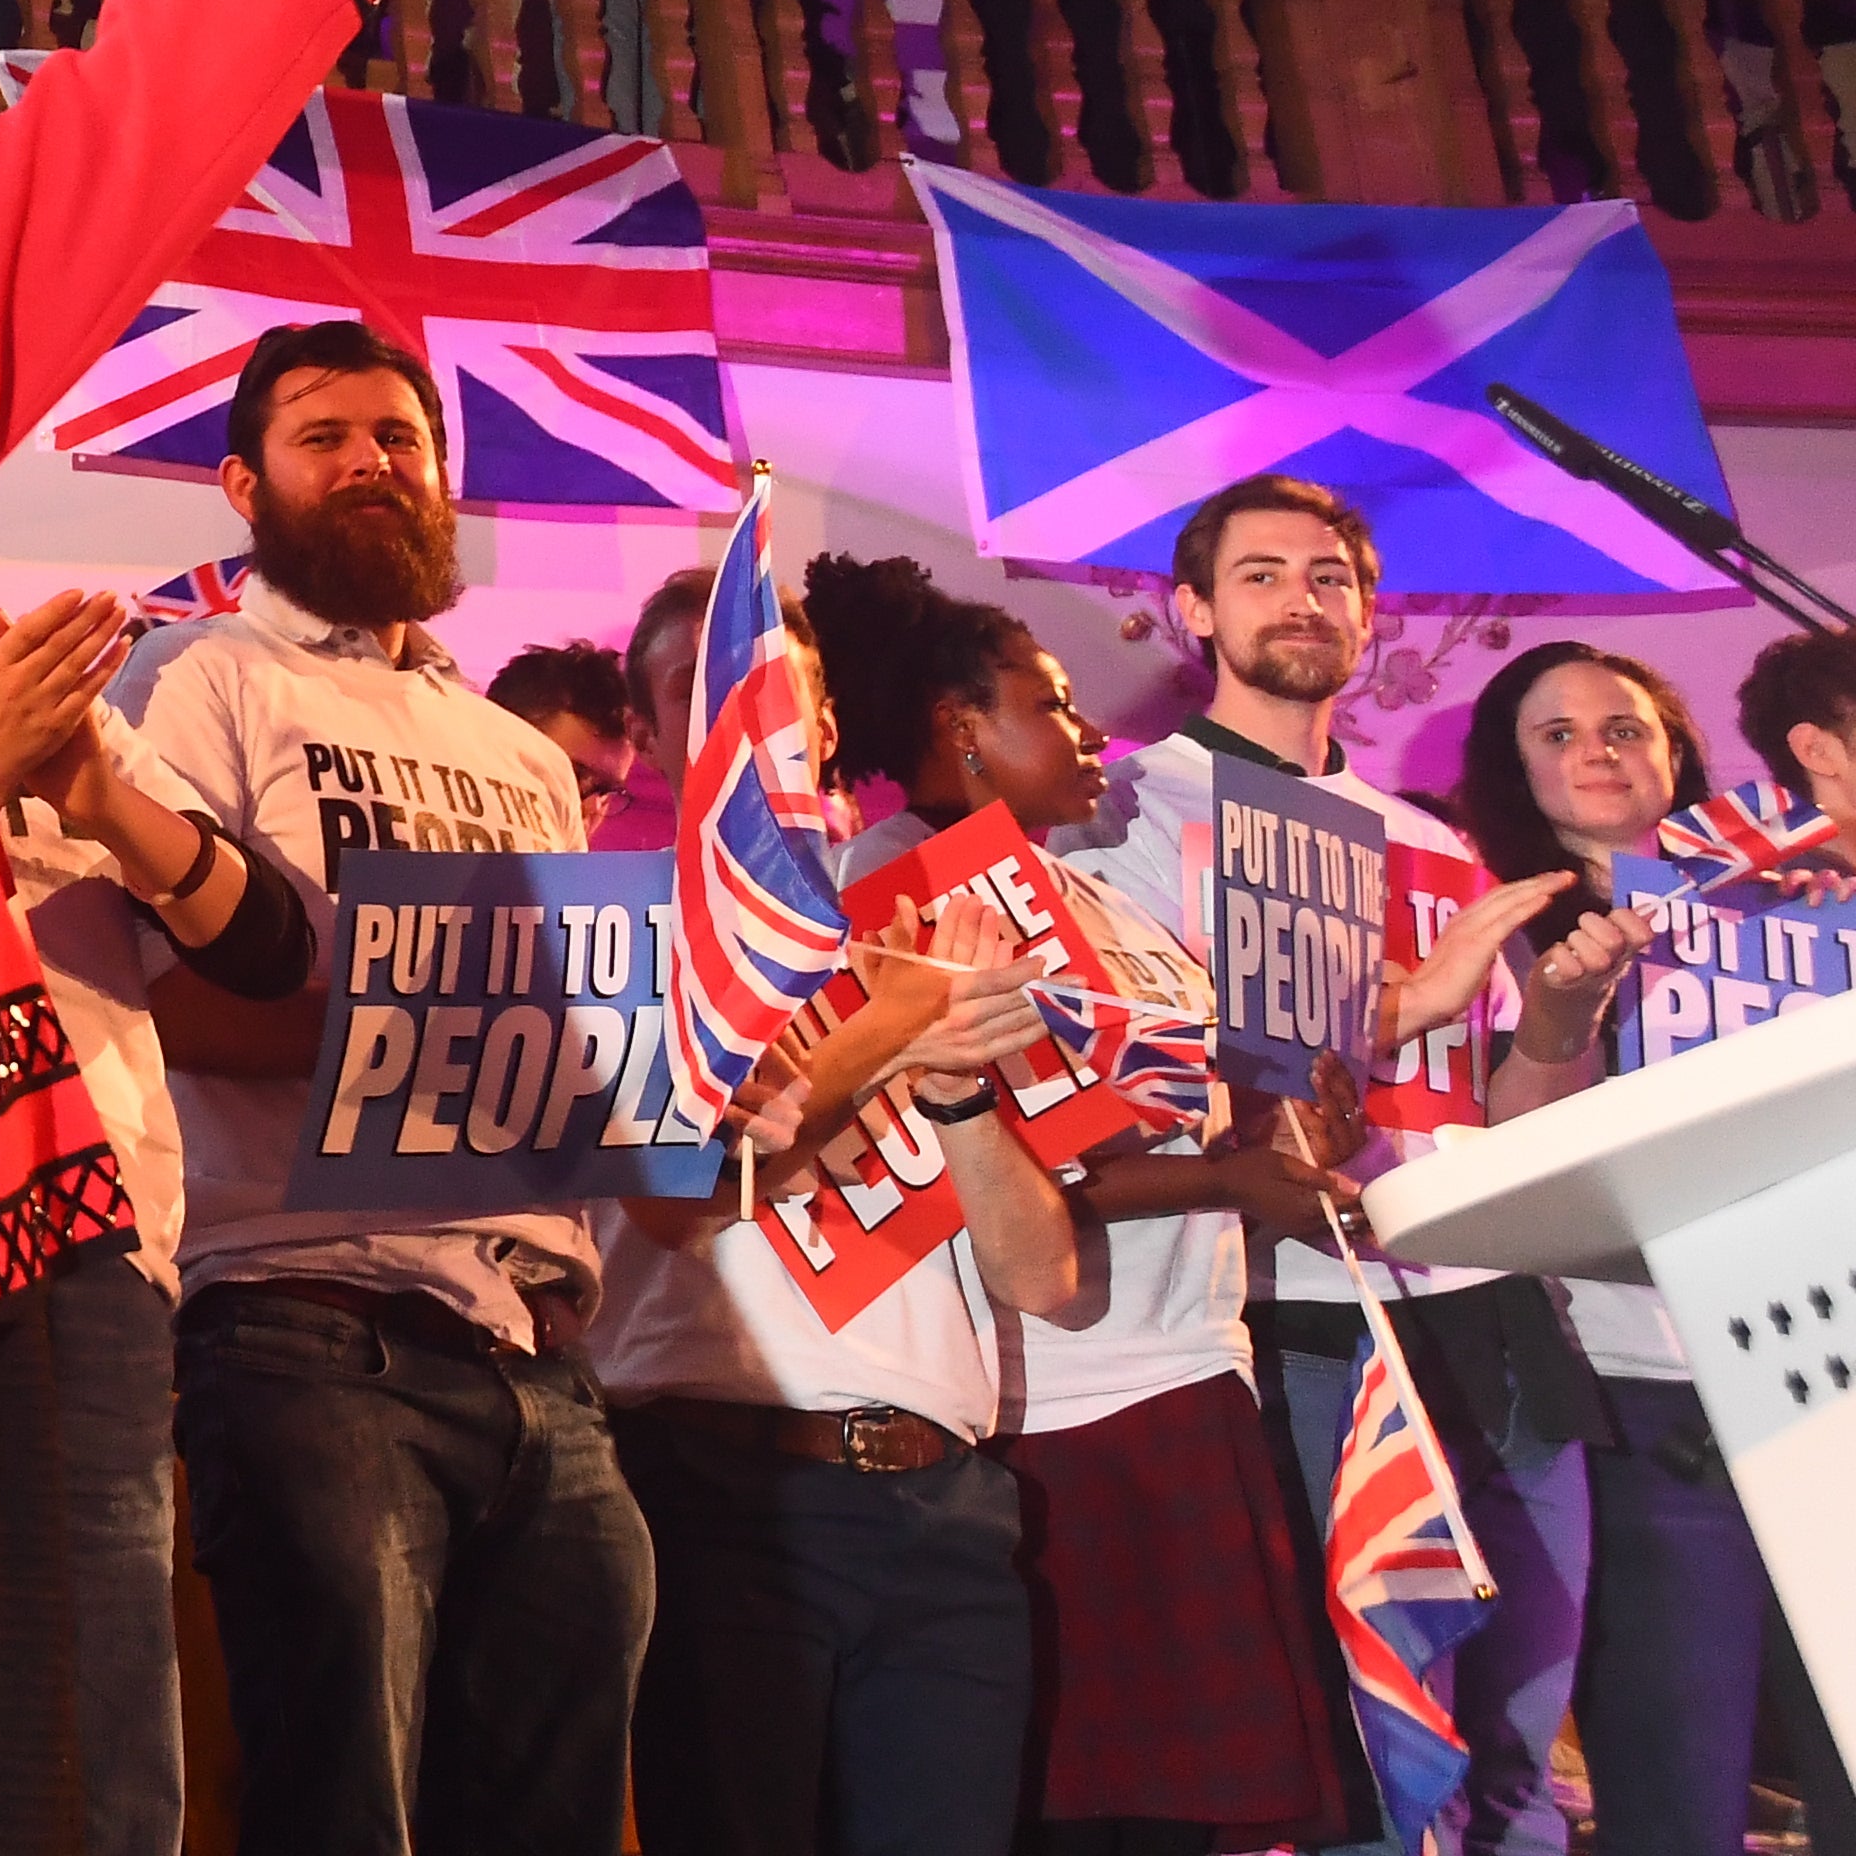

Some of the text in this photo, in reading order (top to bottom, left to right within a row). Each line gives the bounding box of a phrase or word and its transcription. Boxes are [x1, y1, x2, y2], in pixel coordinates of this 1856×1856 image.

[302, 742, 553, 841] PUT IT TO THE
[1221, 799, 1384, 928] PUT IT TO THE
[348, 903, 474, 997] PUT
[487, 905, 546, 996] IT
[560, 903, 631, 997] TO
[1225, 887, 1383, 1052] PEOPLE
[1764, 915, 1820, 987] IT
